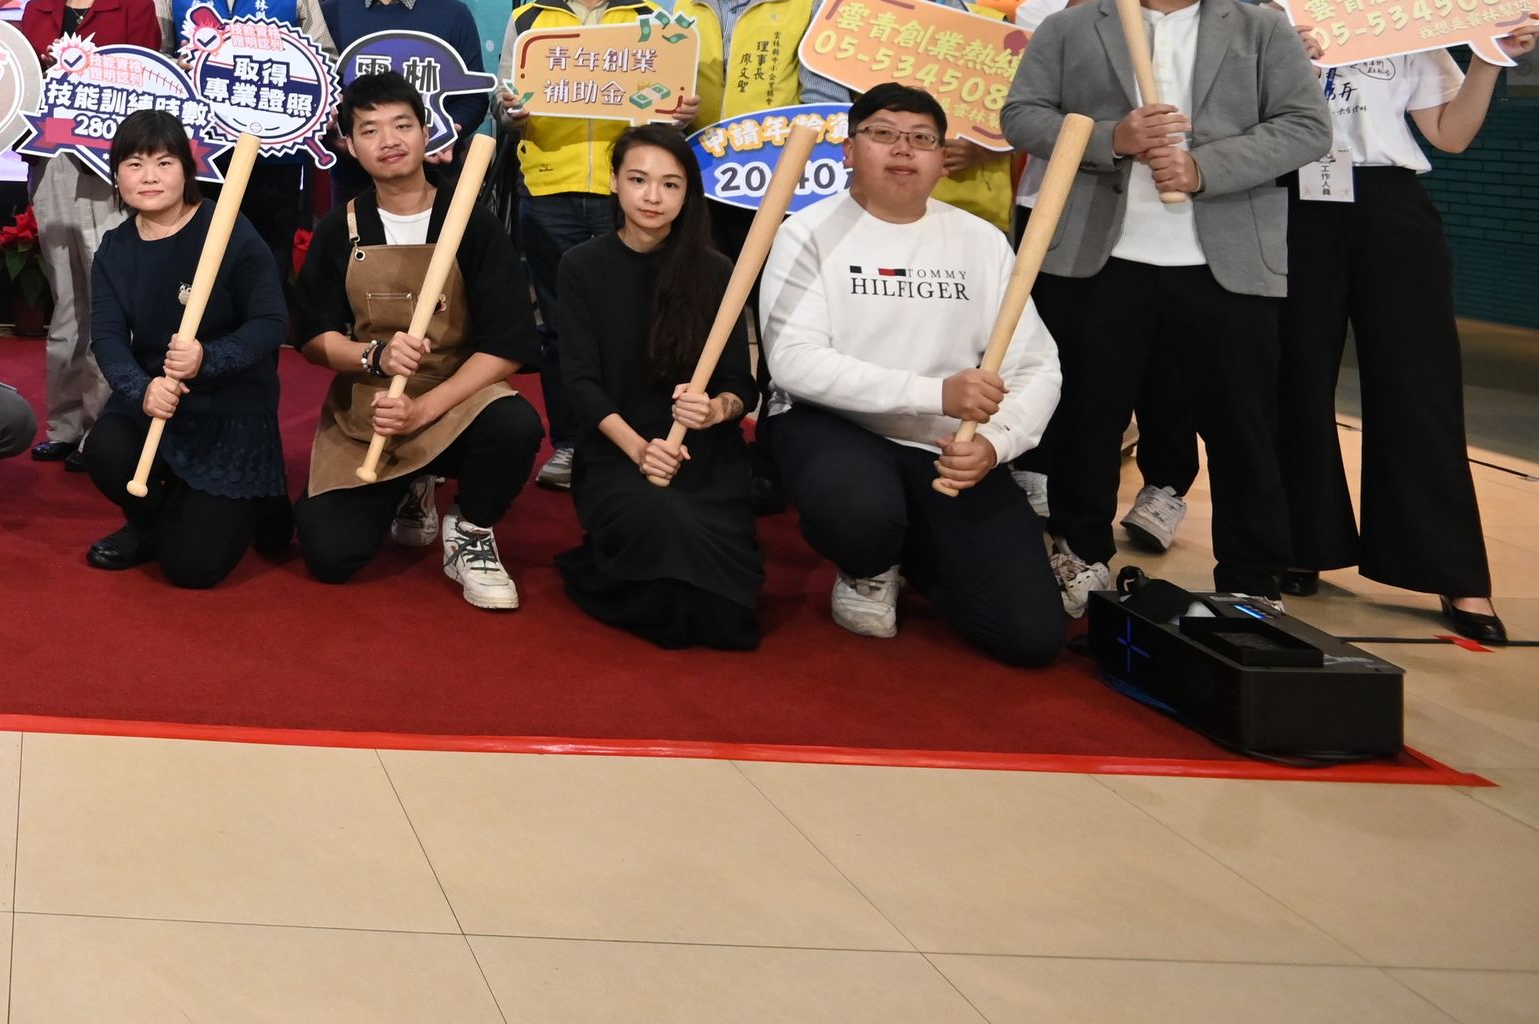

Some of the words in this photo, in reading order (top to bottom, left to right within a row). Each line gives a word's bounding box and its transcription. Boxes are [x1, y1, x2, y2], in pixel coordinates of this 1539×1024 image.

[234, 57, 288, 87] 取得
[546, 47, 657, 73] 青年創業
[754, 41, 769, 80] 理事長
[203, 78, 313, 118] 專業證照
[544, 80, 626, 105] 補助金
[907, 269, 967, 280] TOMMY
[851, 277, 971, 301] HILFIGER
